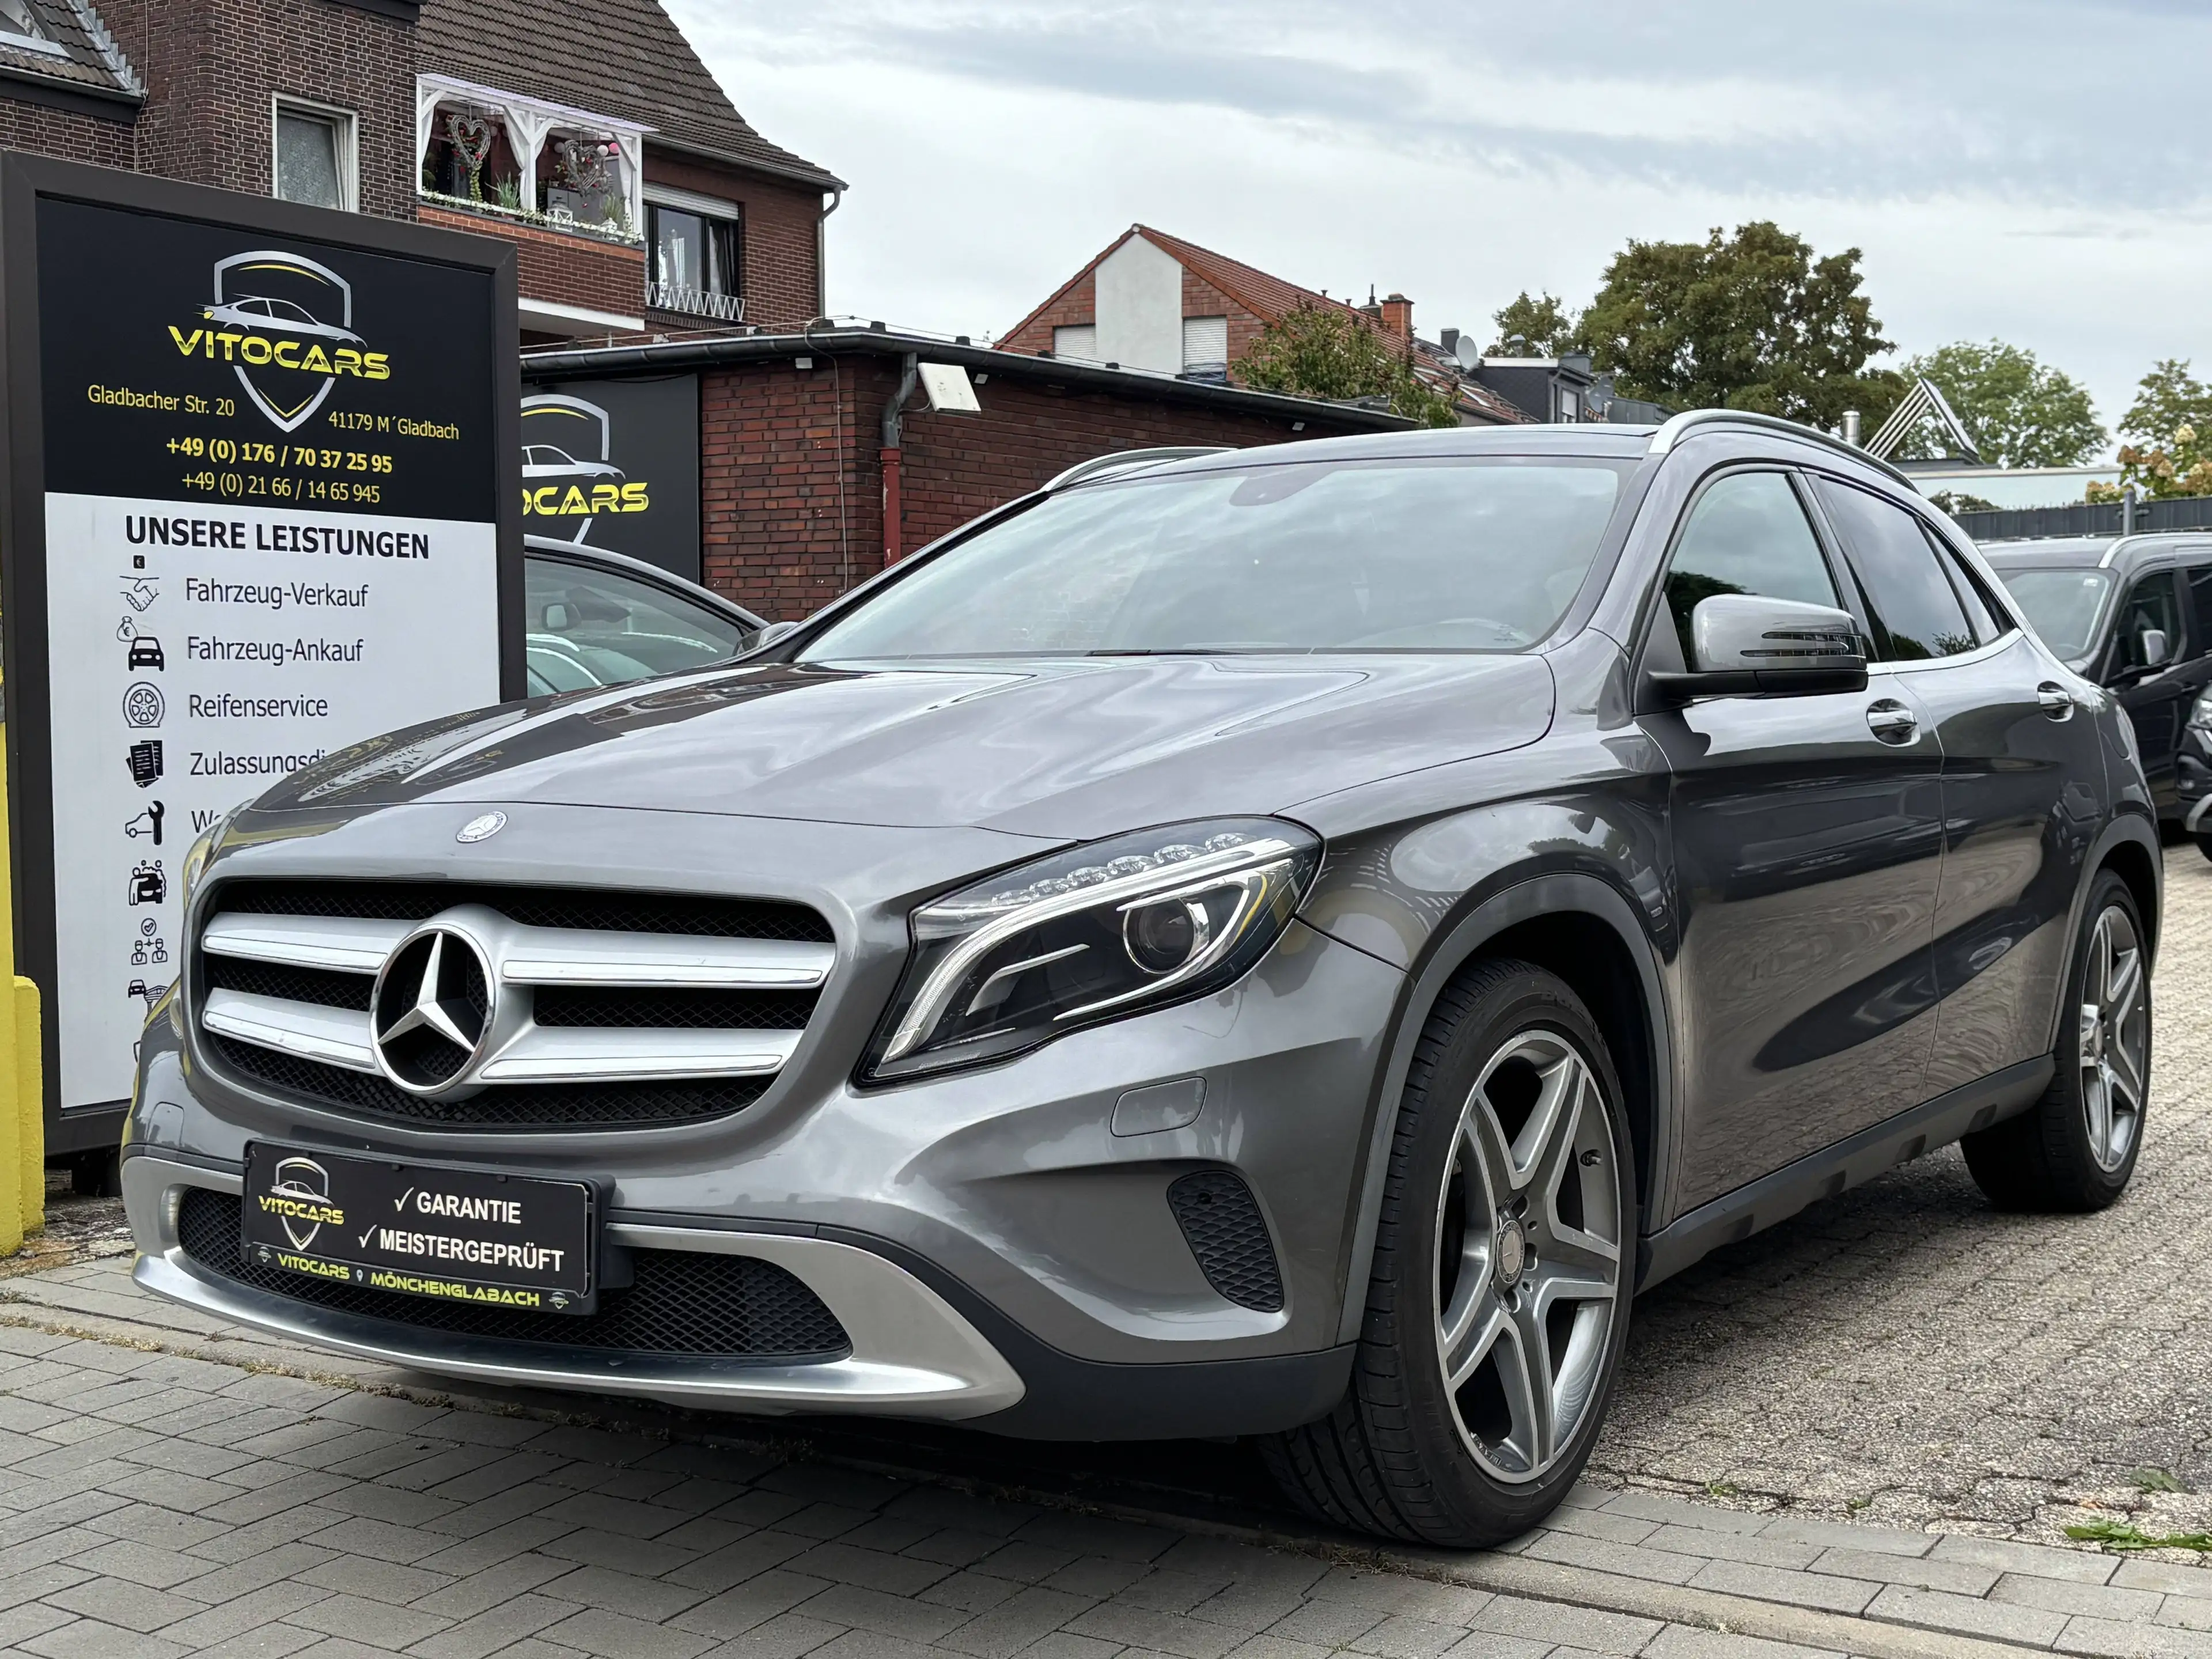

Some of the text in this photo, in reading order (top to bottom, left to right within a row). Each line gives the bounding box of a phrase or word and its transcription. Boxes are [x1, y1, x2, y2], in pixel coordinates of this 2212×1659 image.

[168, 325, 391, 380] VITOCARS
[88, 385, 234, 416] Gladbacher Str. 20
[328, 411, 373, 431] 41179
[167, 438, 392, 474] +49 (0) 176 / 70 37 25 95
[182, 472, 380, 502] +49 (0) 21 66 / 14 65 945
[126, 516, 428, 559] UNSERE LEISTUNGEN
[187, 578, 369, 609] Fahrzeug-Verkauf
[188, 636, 363, 666] Fahrzeug-Ankauf
[190, 694, 327, 717] Reifenservice
[258, 1195, 344, 1225] VITOCARS
[417, 1192, 521, 1224] GARANTIE
[380, 1229, 564, 1272] MEISTERGEPRÜFT
[277, 1253, 540, 1307] VITOCARS MÖNCHENGLABACH
